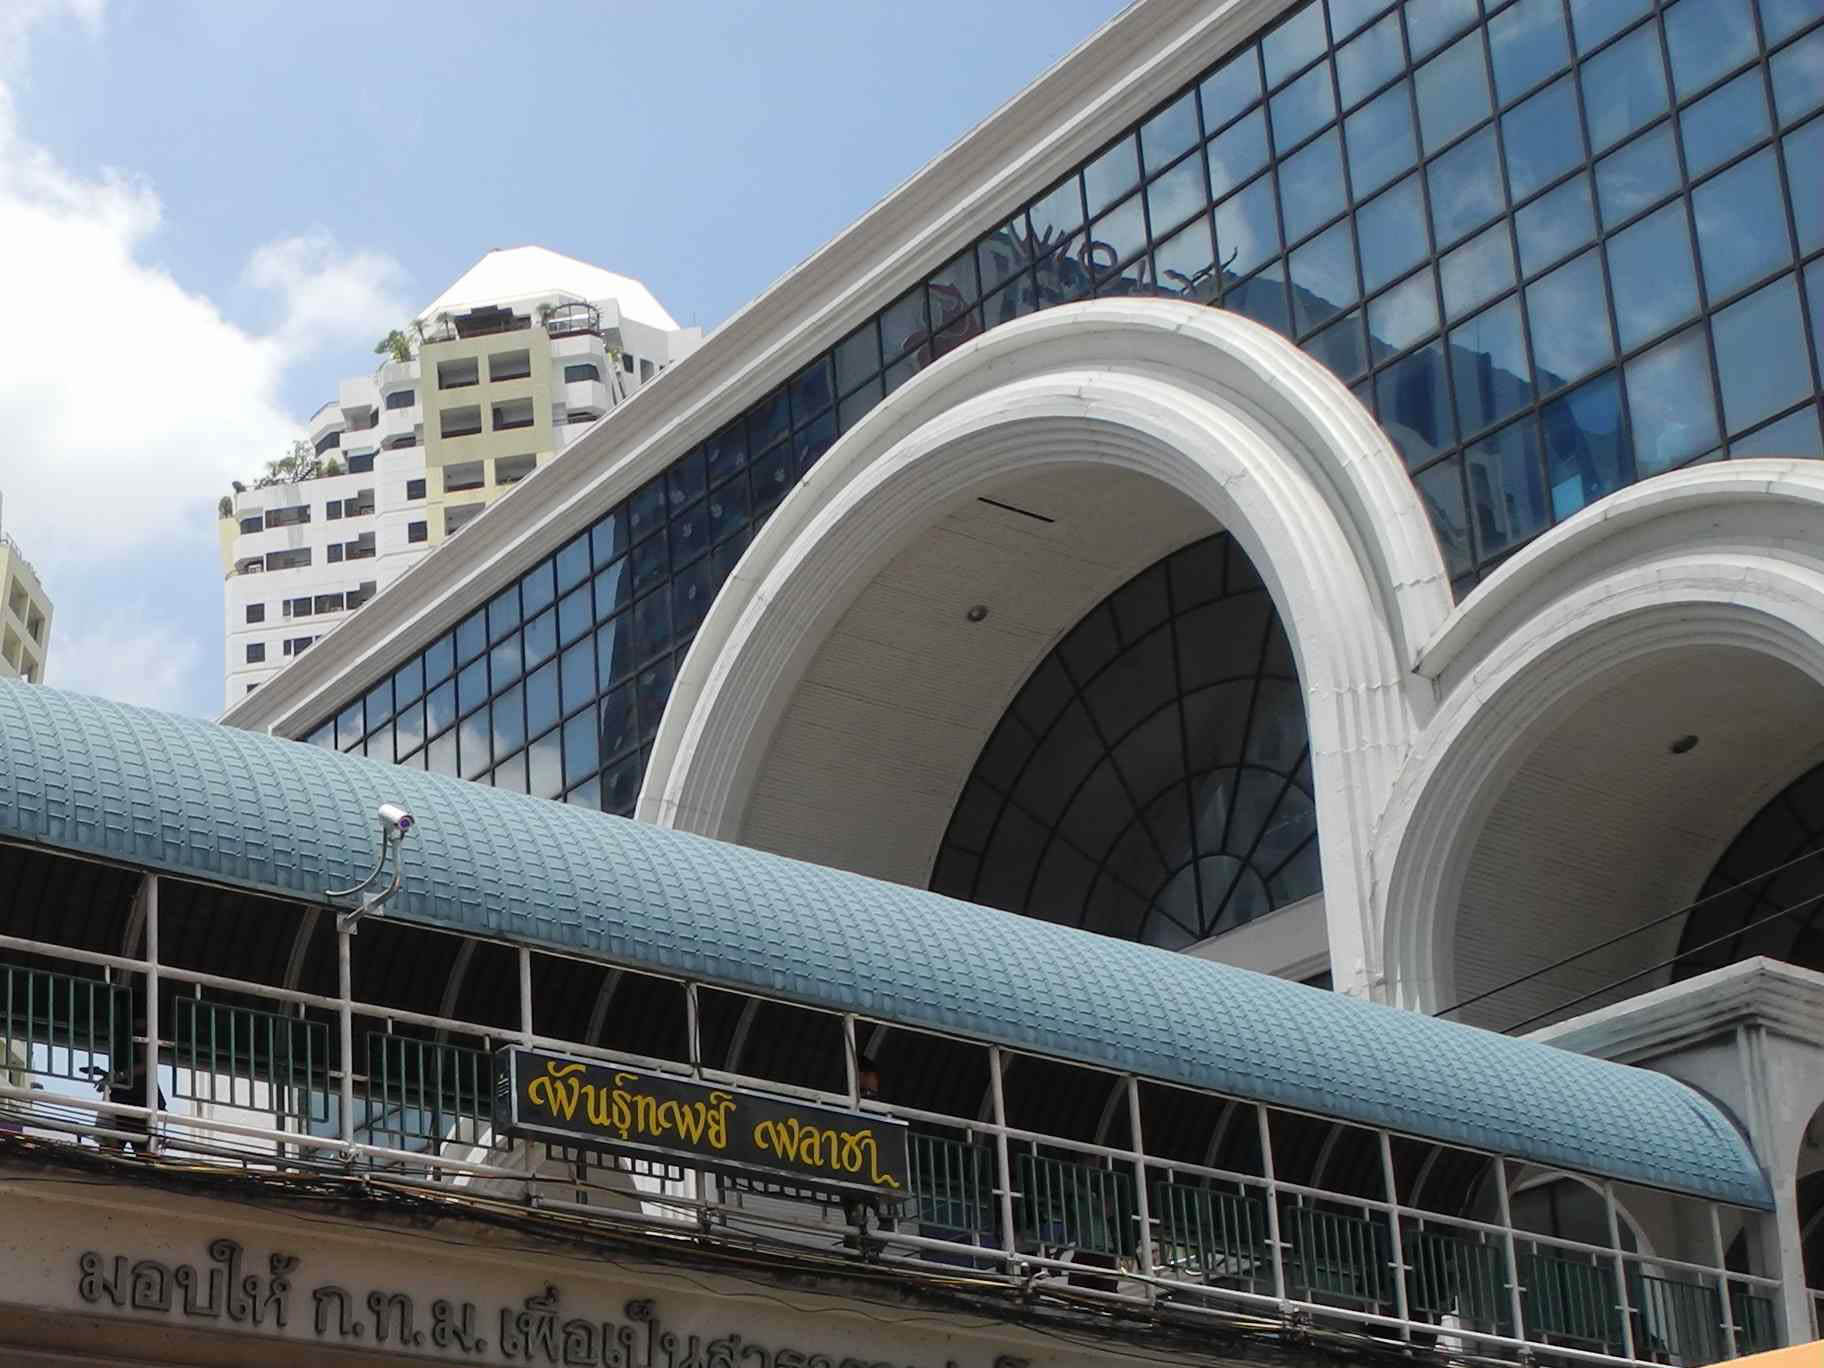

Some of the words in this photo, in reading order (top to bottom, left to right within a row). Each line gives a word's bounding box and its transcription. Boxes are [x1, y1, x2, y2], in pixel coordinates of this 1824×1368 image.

[78, 1238, 297, 1328] มอบให้
[313, 1277, 487, 1357] ก.ท.ม.
